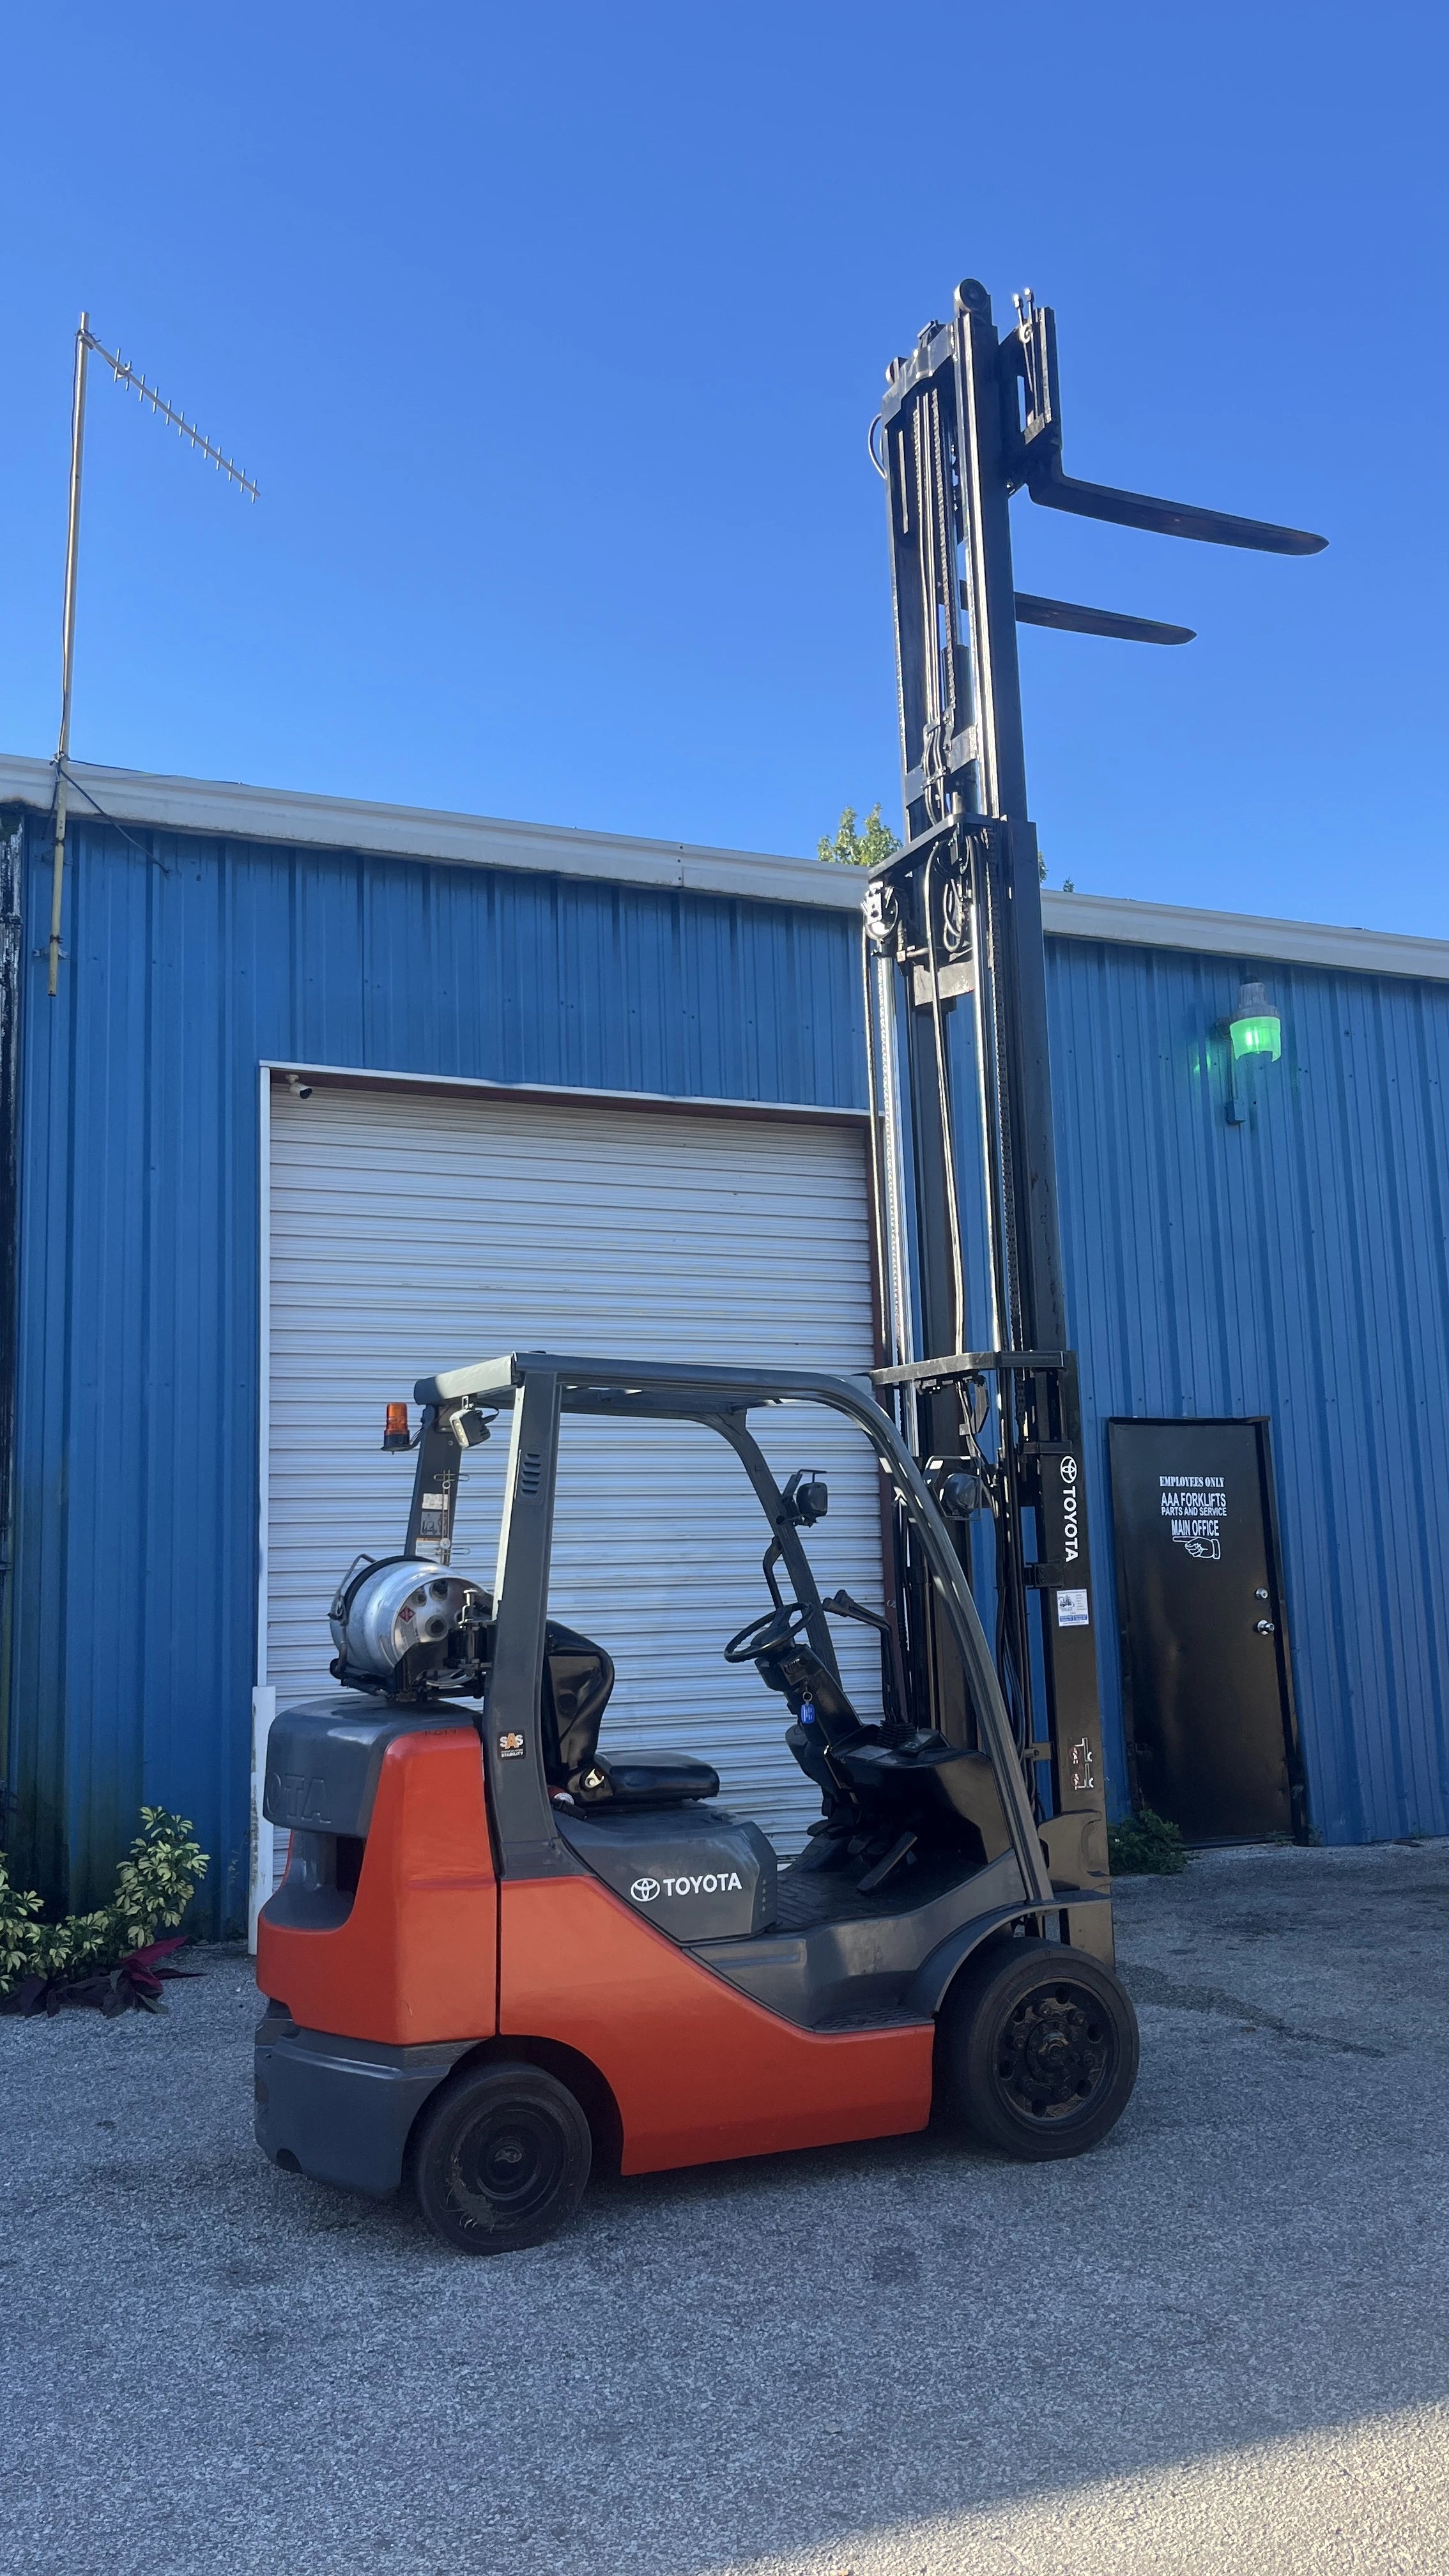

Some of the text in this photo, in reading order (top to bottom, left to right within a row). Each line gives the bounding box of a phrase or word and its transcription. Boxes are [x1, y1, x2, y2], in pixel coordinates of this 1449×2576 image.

[1160, 1476, 1225, 1487] EMPLOYEES ONLY
[1161, 1492, 1227, 1507] AAA FORKLIFTS
[1162, 1506, 1227, 1516] PARTS AND SERVICE
[1063, 1485, 1078, 1562] TOYOTA
[1171, 1519, 1220, 1537] MAIN OFFICE
[500, 1733, 524, 1749] SAS
[265, 1770, 332, 1824] OTA
[663, 1873, 742, 1897] TOYOTA
